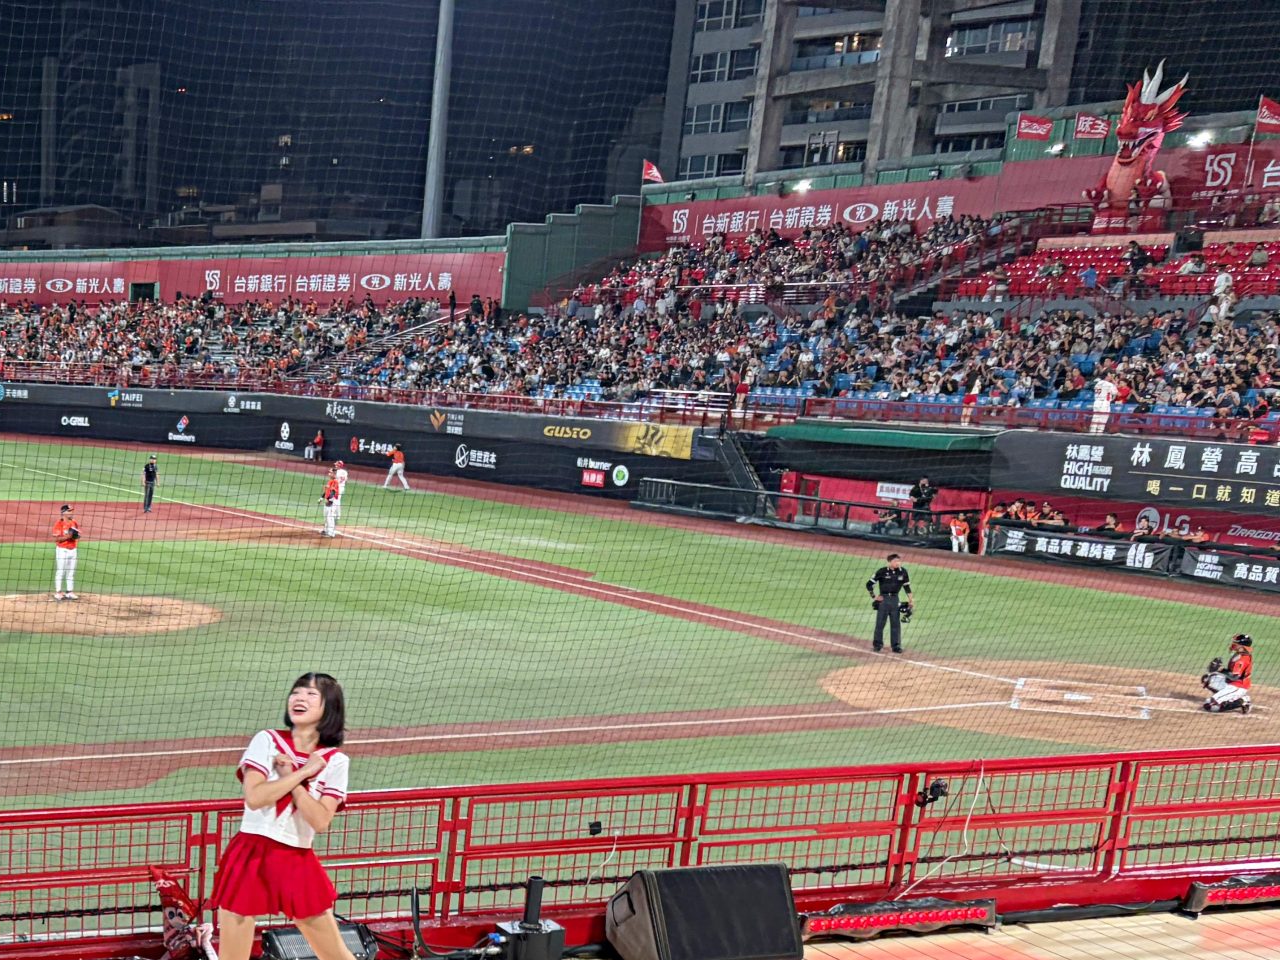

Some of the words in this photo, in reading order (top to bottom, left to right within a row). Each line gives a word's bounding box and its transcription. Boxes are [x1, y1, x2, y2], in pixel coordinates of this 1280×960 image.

[703, 210, 759, 234] 台新銀行
[770, 204, 831, 231] 台新證券
[883, 197, 954, 222] 新光人壽
[76, 278, 125, 294] 新光人壽
[234, 275, 287, 292] 台新銀行
[296, 275, 351, 292] 台新證券
[393, 273, 452, 291] 新光人壽
[122, 393, 143, 402] TAIPEI
[168, 432, 195, 442] Domino's
[544, 426, 592, 440] GUSTO
[1063, 461, 1093, 475] HIGH
[1061, 475, 1111, 492] QUALITY
[1146, 479, 1280, 508] 喝一口就知道
[1164, 513, 1191, 536] LG
[1035, 537, 1074, 556] 高品質
[1233, 562, 1280, 584] 高品質
